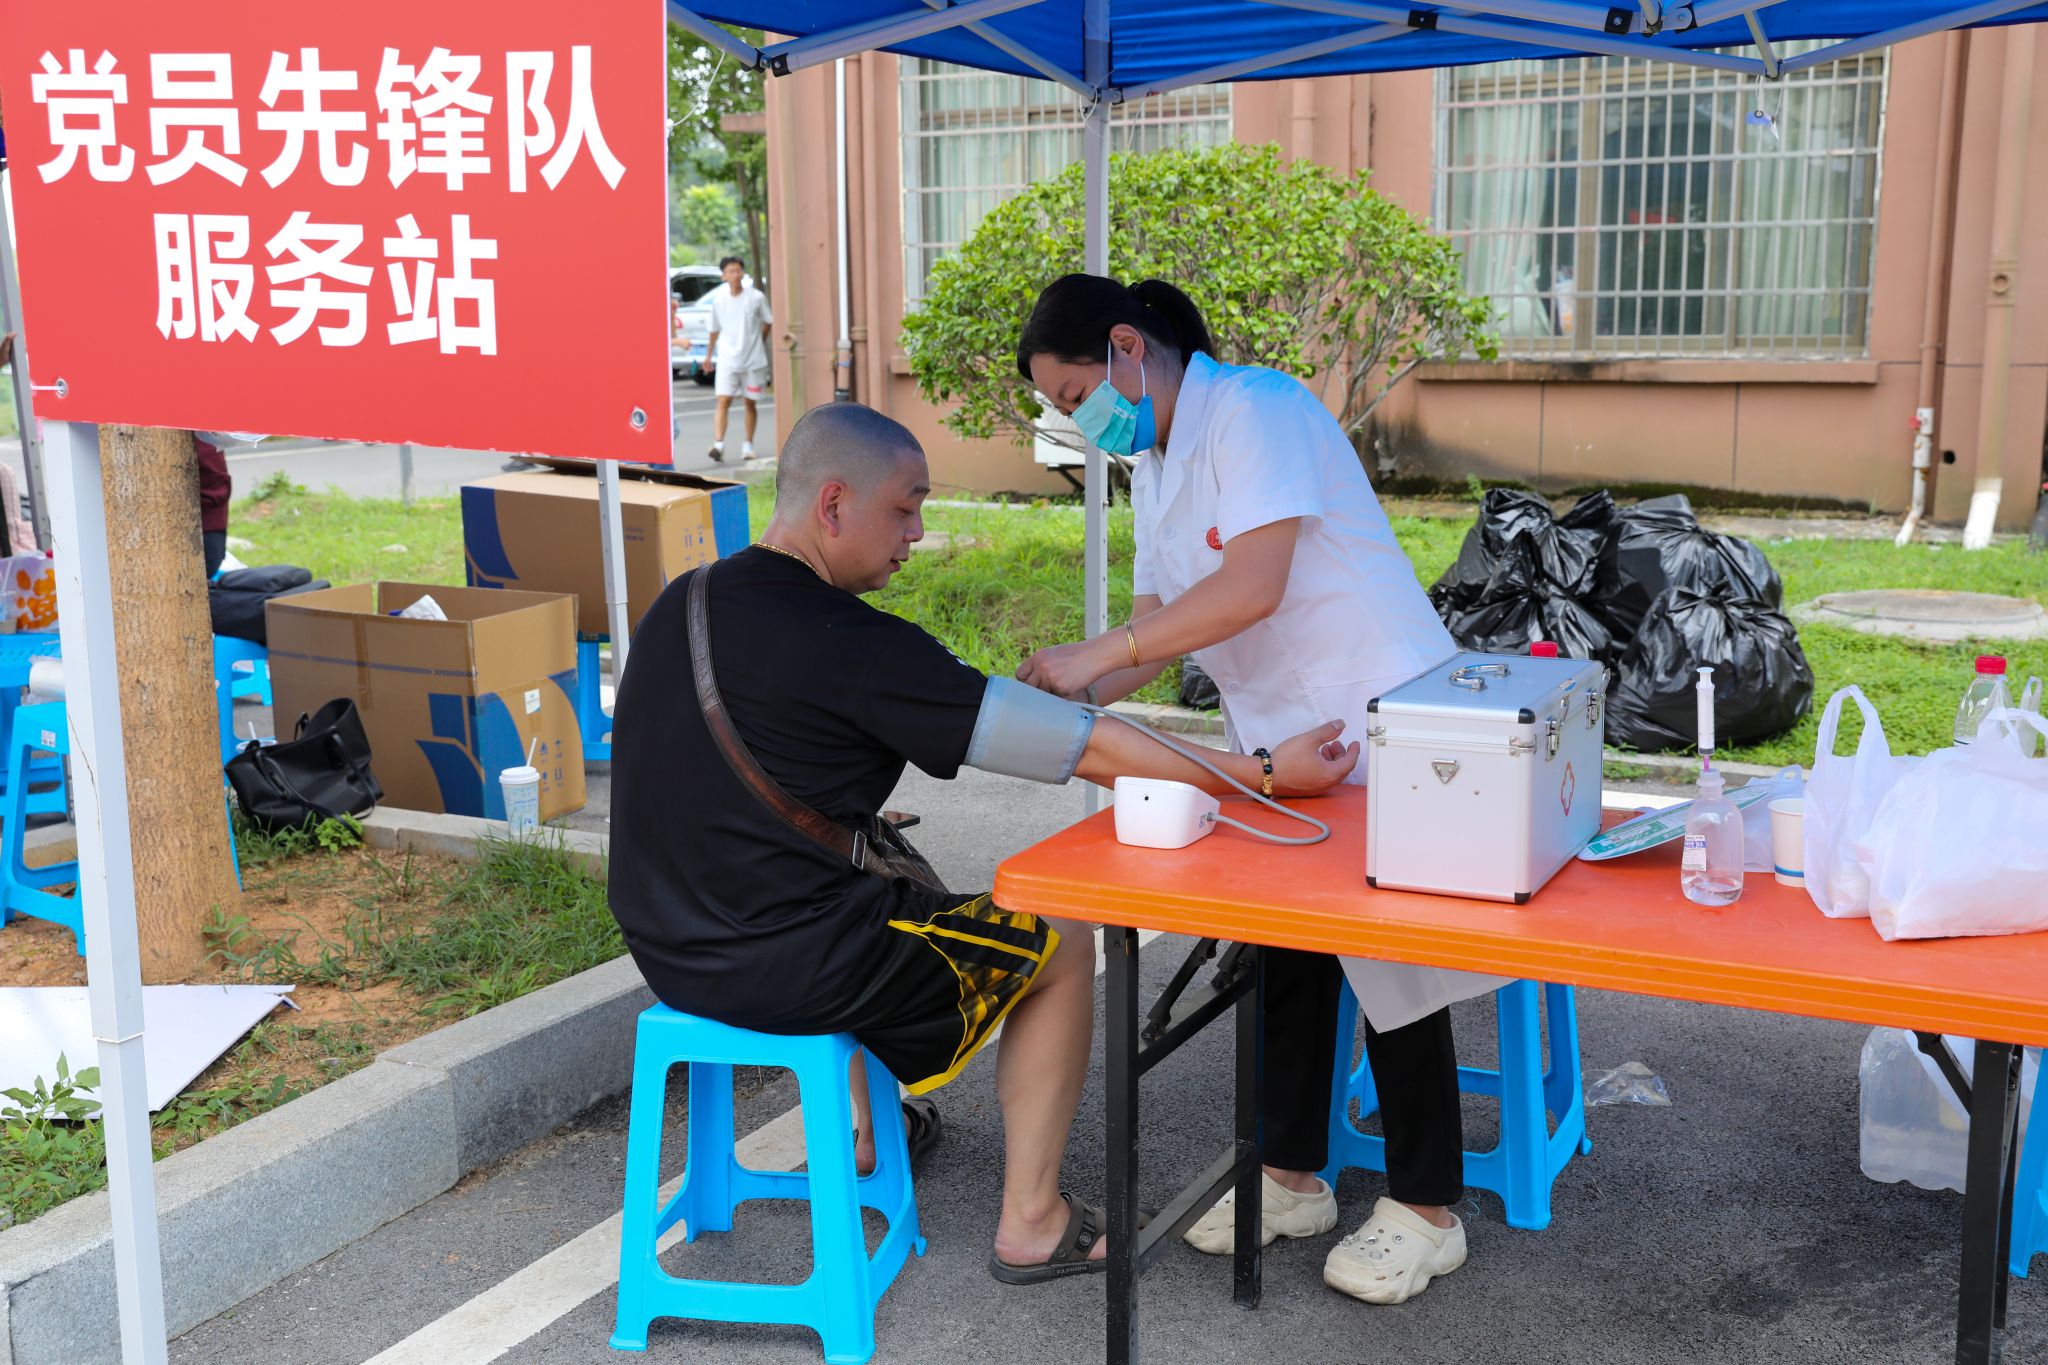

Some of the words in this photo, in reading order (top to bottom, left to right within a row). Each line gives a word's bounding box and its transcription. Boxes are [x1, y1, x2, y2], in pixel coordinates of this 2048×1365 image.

[31, 45, 626, 192] 党员先锋队
[154, 211, 497, 355] 服务站
